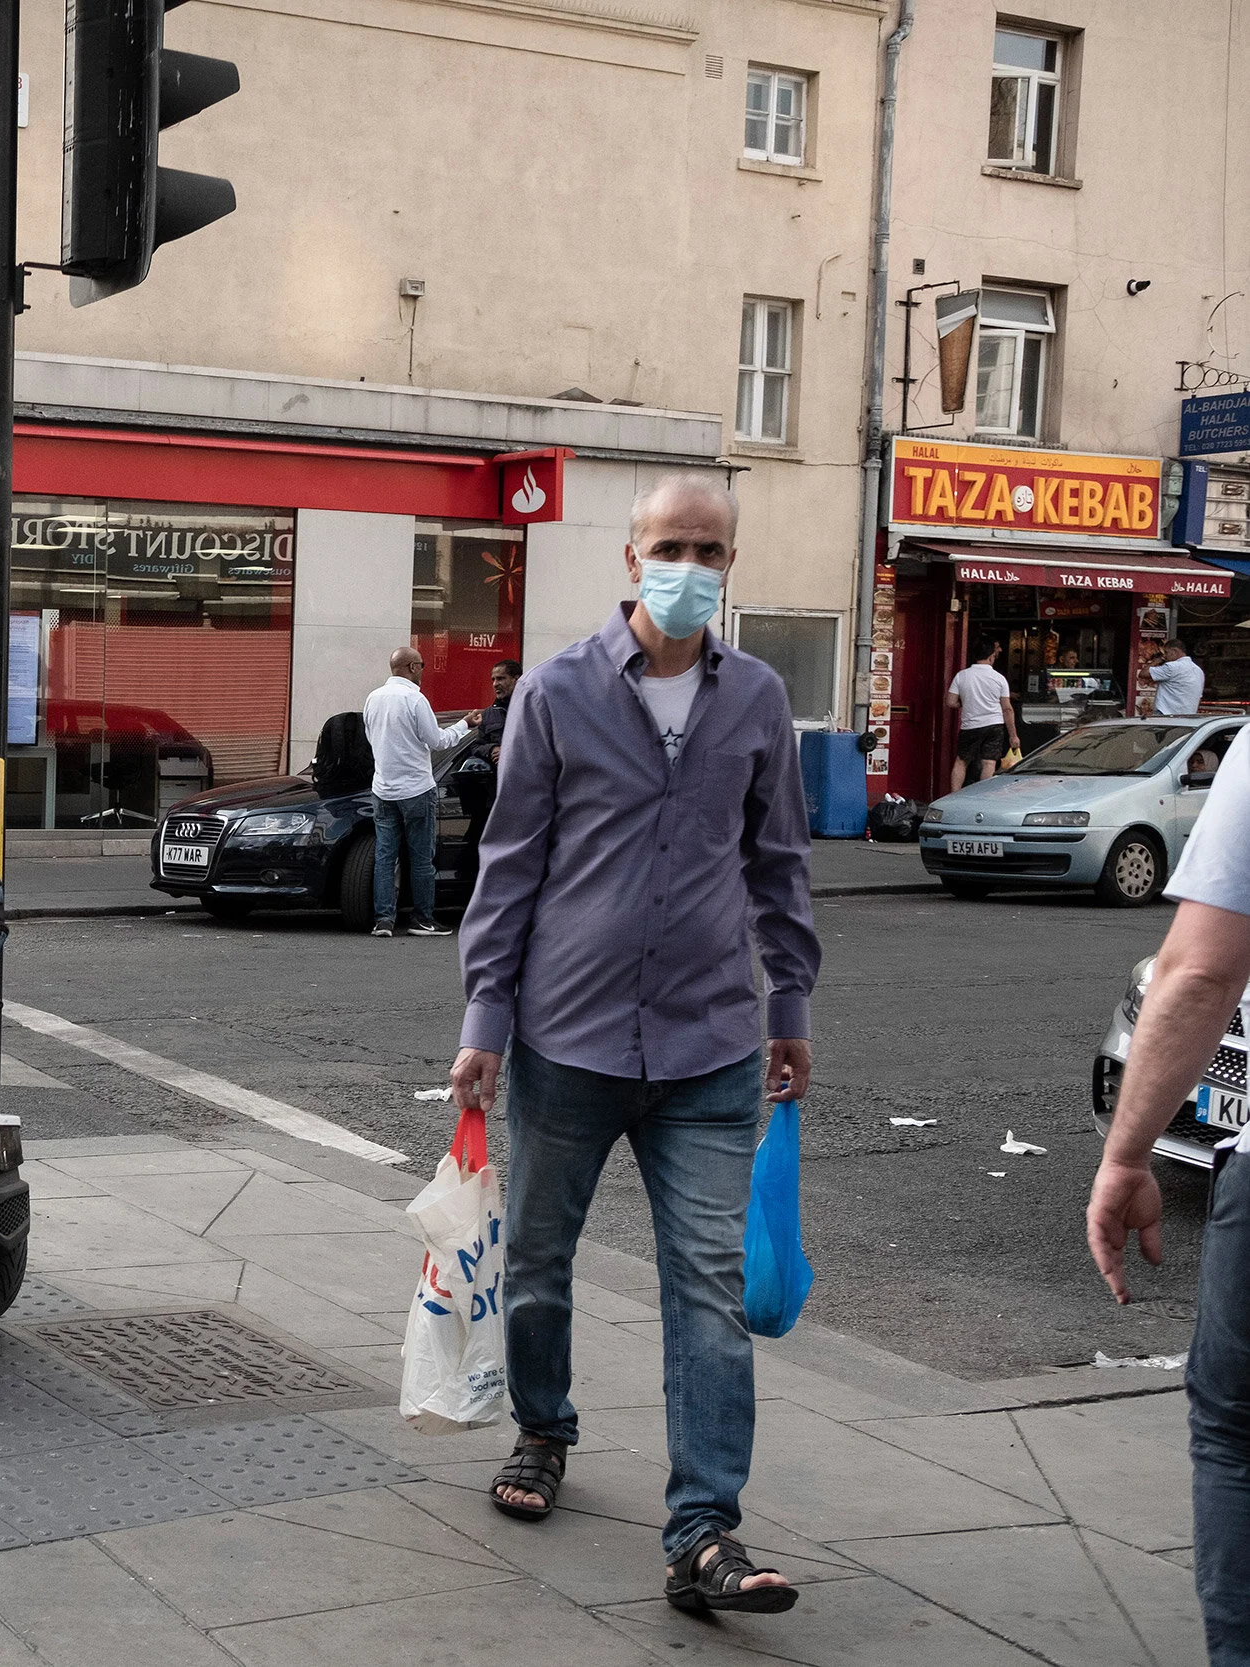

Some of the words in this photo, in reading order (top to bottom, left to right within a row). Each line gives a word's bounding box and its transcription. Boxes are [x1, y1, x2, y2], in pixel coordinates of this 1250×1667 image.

[1184, 397, 1250, 414] AL-BAHDJA
[1200, 413, 1237, 426] HALAL
[1188, 425, 1249, 441] BUTCHERS
[912, 446, 940, 460] HALAL
[904, 465, 1015, 522] TAZA
[1032, 475, 1155, 531] KEBAB
[960, 567, 1003, 582] HALAL
[1060, 574, 1093, 588] TAZA
[1097, 576, 1134, 590] KEBAB
[1186, 582, 1225, 595] HALAL
[894, 639, 906, 650] 42
[167, 847, 183, 861] K77
[184, 848, 202, 863] WAR
[952, 841, 975, 854] EX51
[977, 842, 998, 855] AFU
[1218, 1094, 1250, 1127] KU
[467, 1373, 481, 1383] We
[483, 1369, 498, 1379] are
[469, 1391, 504, 1405] tesco.co
